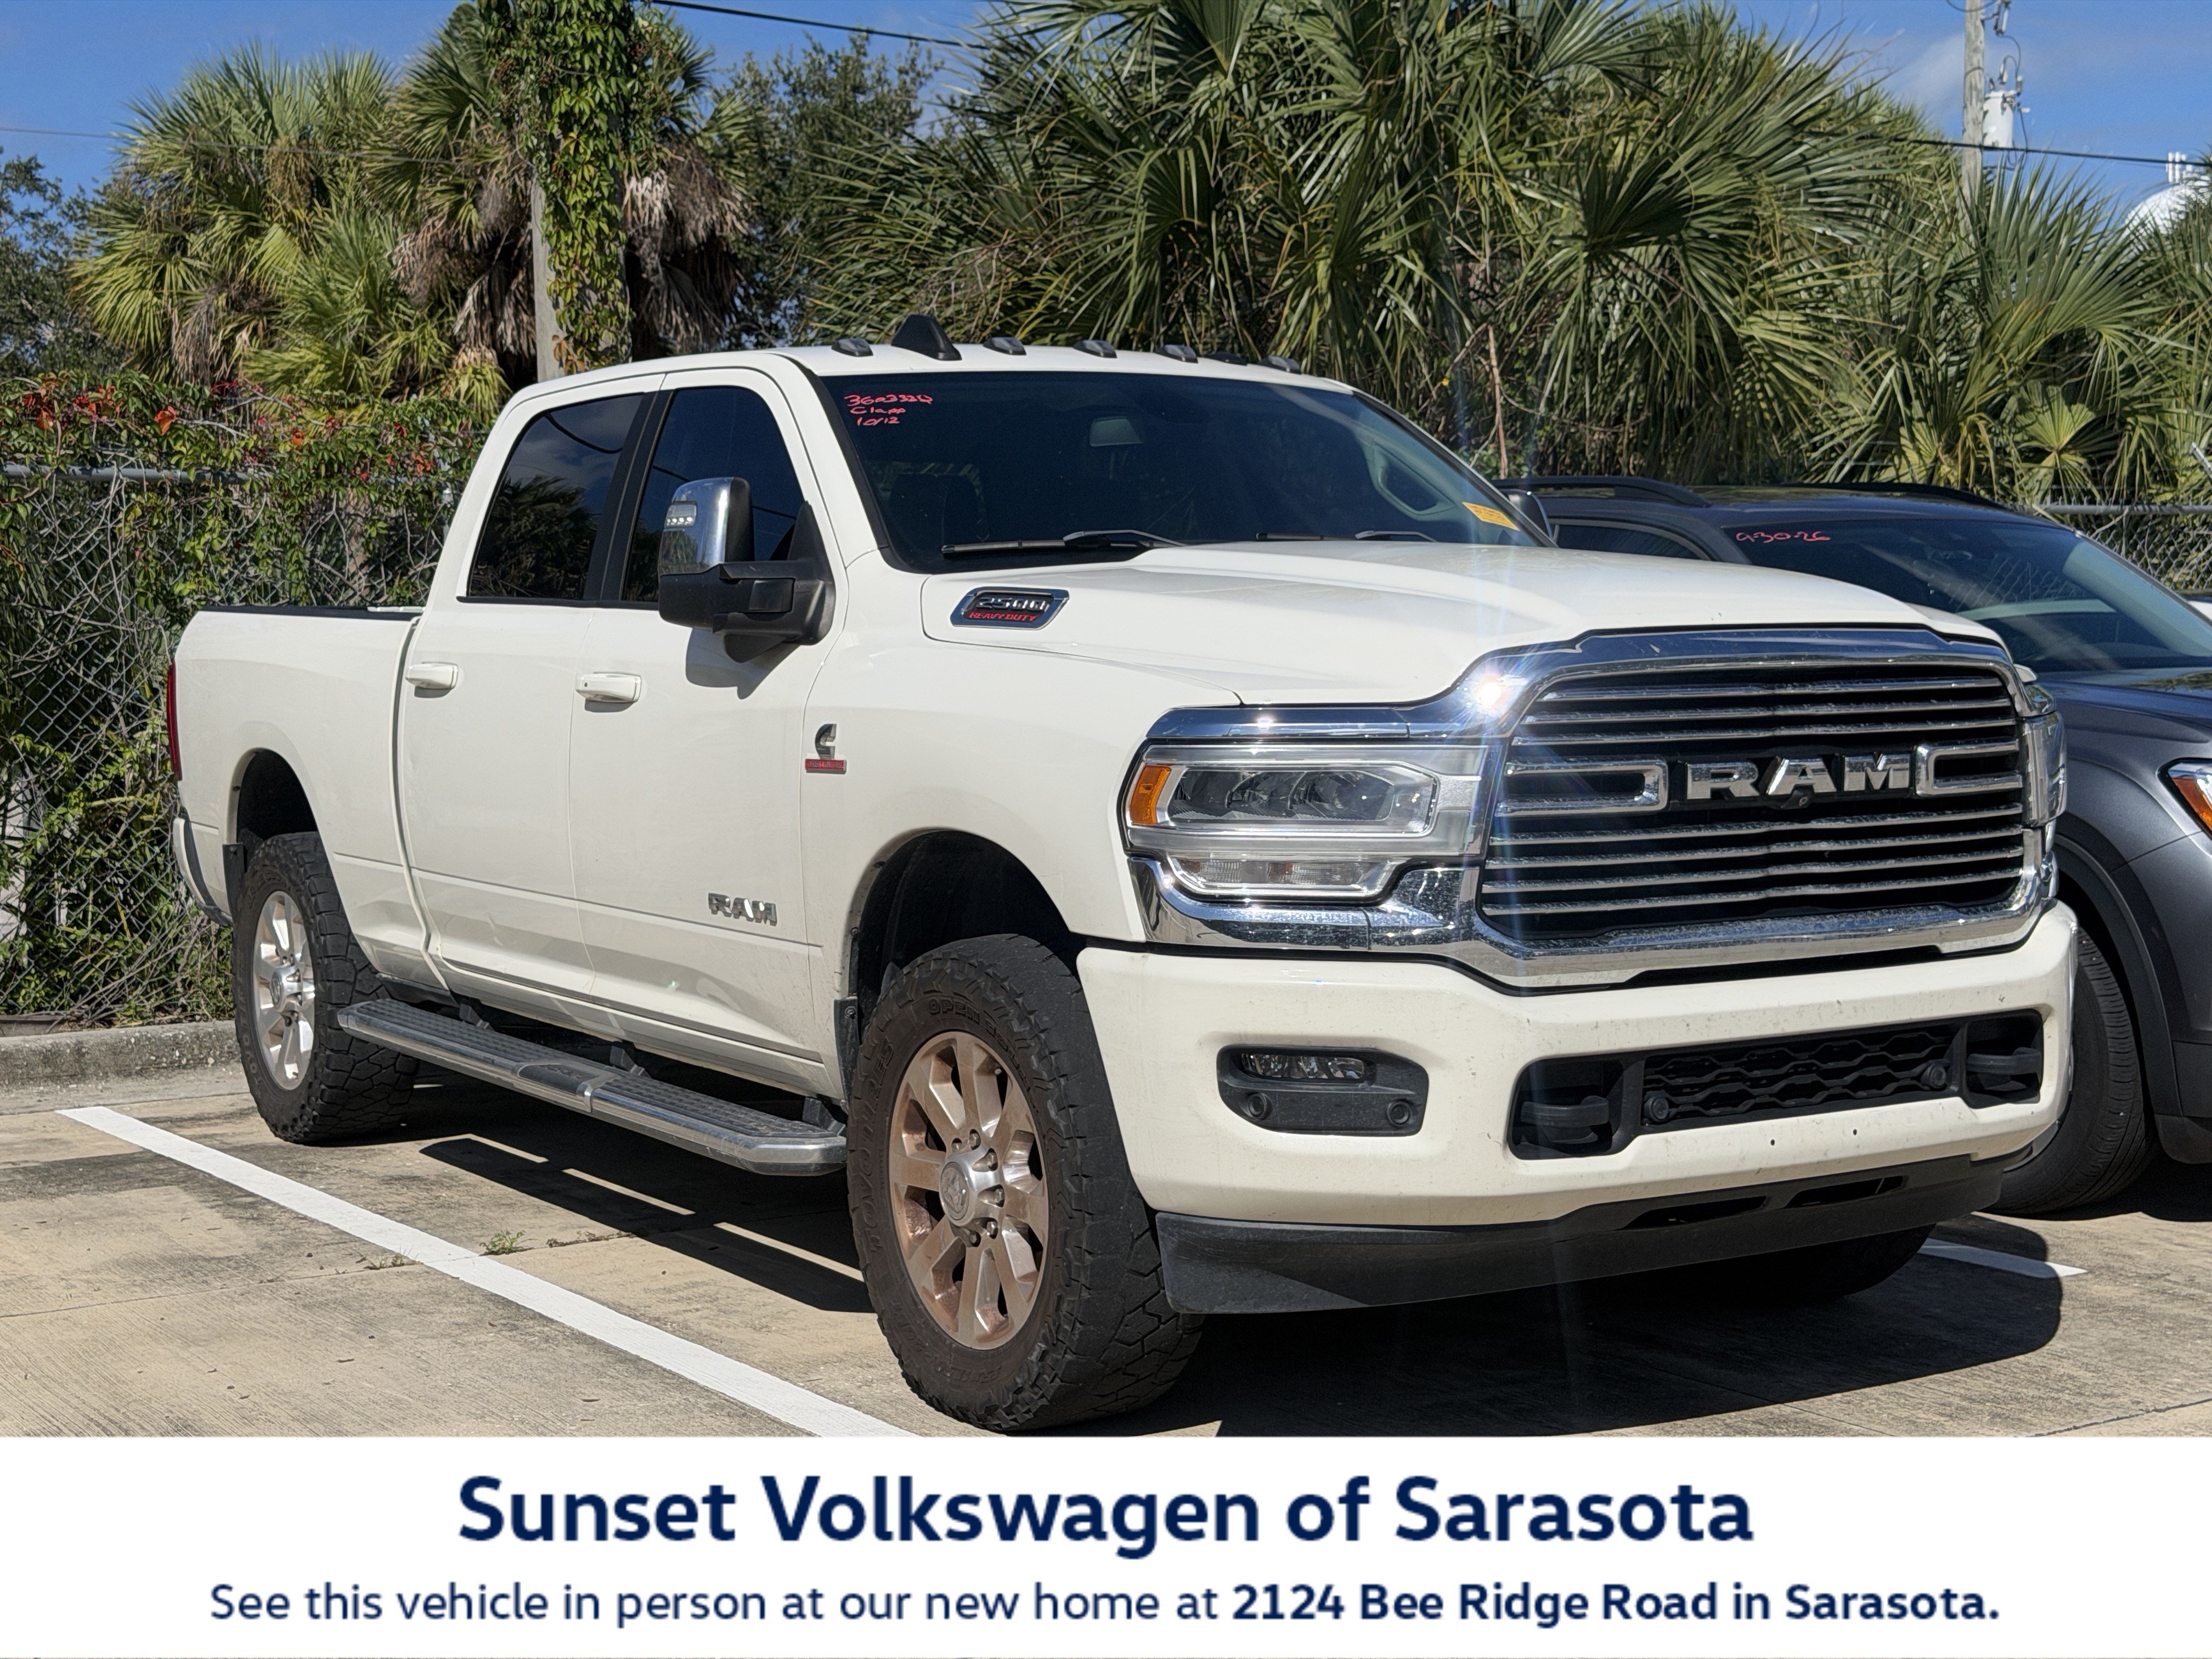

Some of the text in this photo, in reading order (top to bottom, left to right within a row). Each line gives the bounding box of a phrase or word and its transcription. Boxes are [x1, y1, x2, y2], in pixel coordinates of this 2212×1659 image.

[969, 611, 1037, 622] HEAVY DUTY
[975, 596, 1046, 610] 2500
[1686, 753, 1910, 799] RAM
[708, 892, 778, 927] RAM
[928, 997, 980, 1025] OPEN
